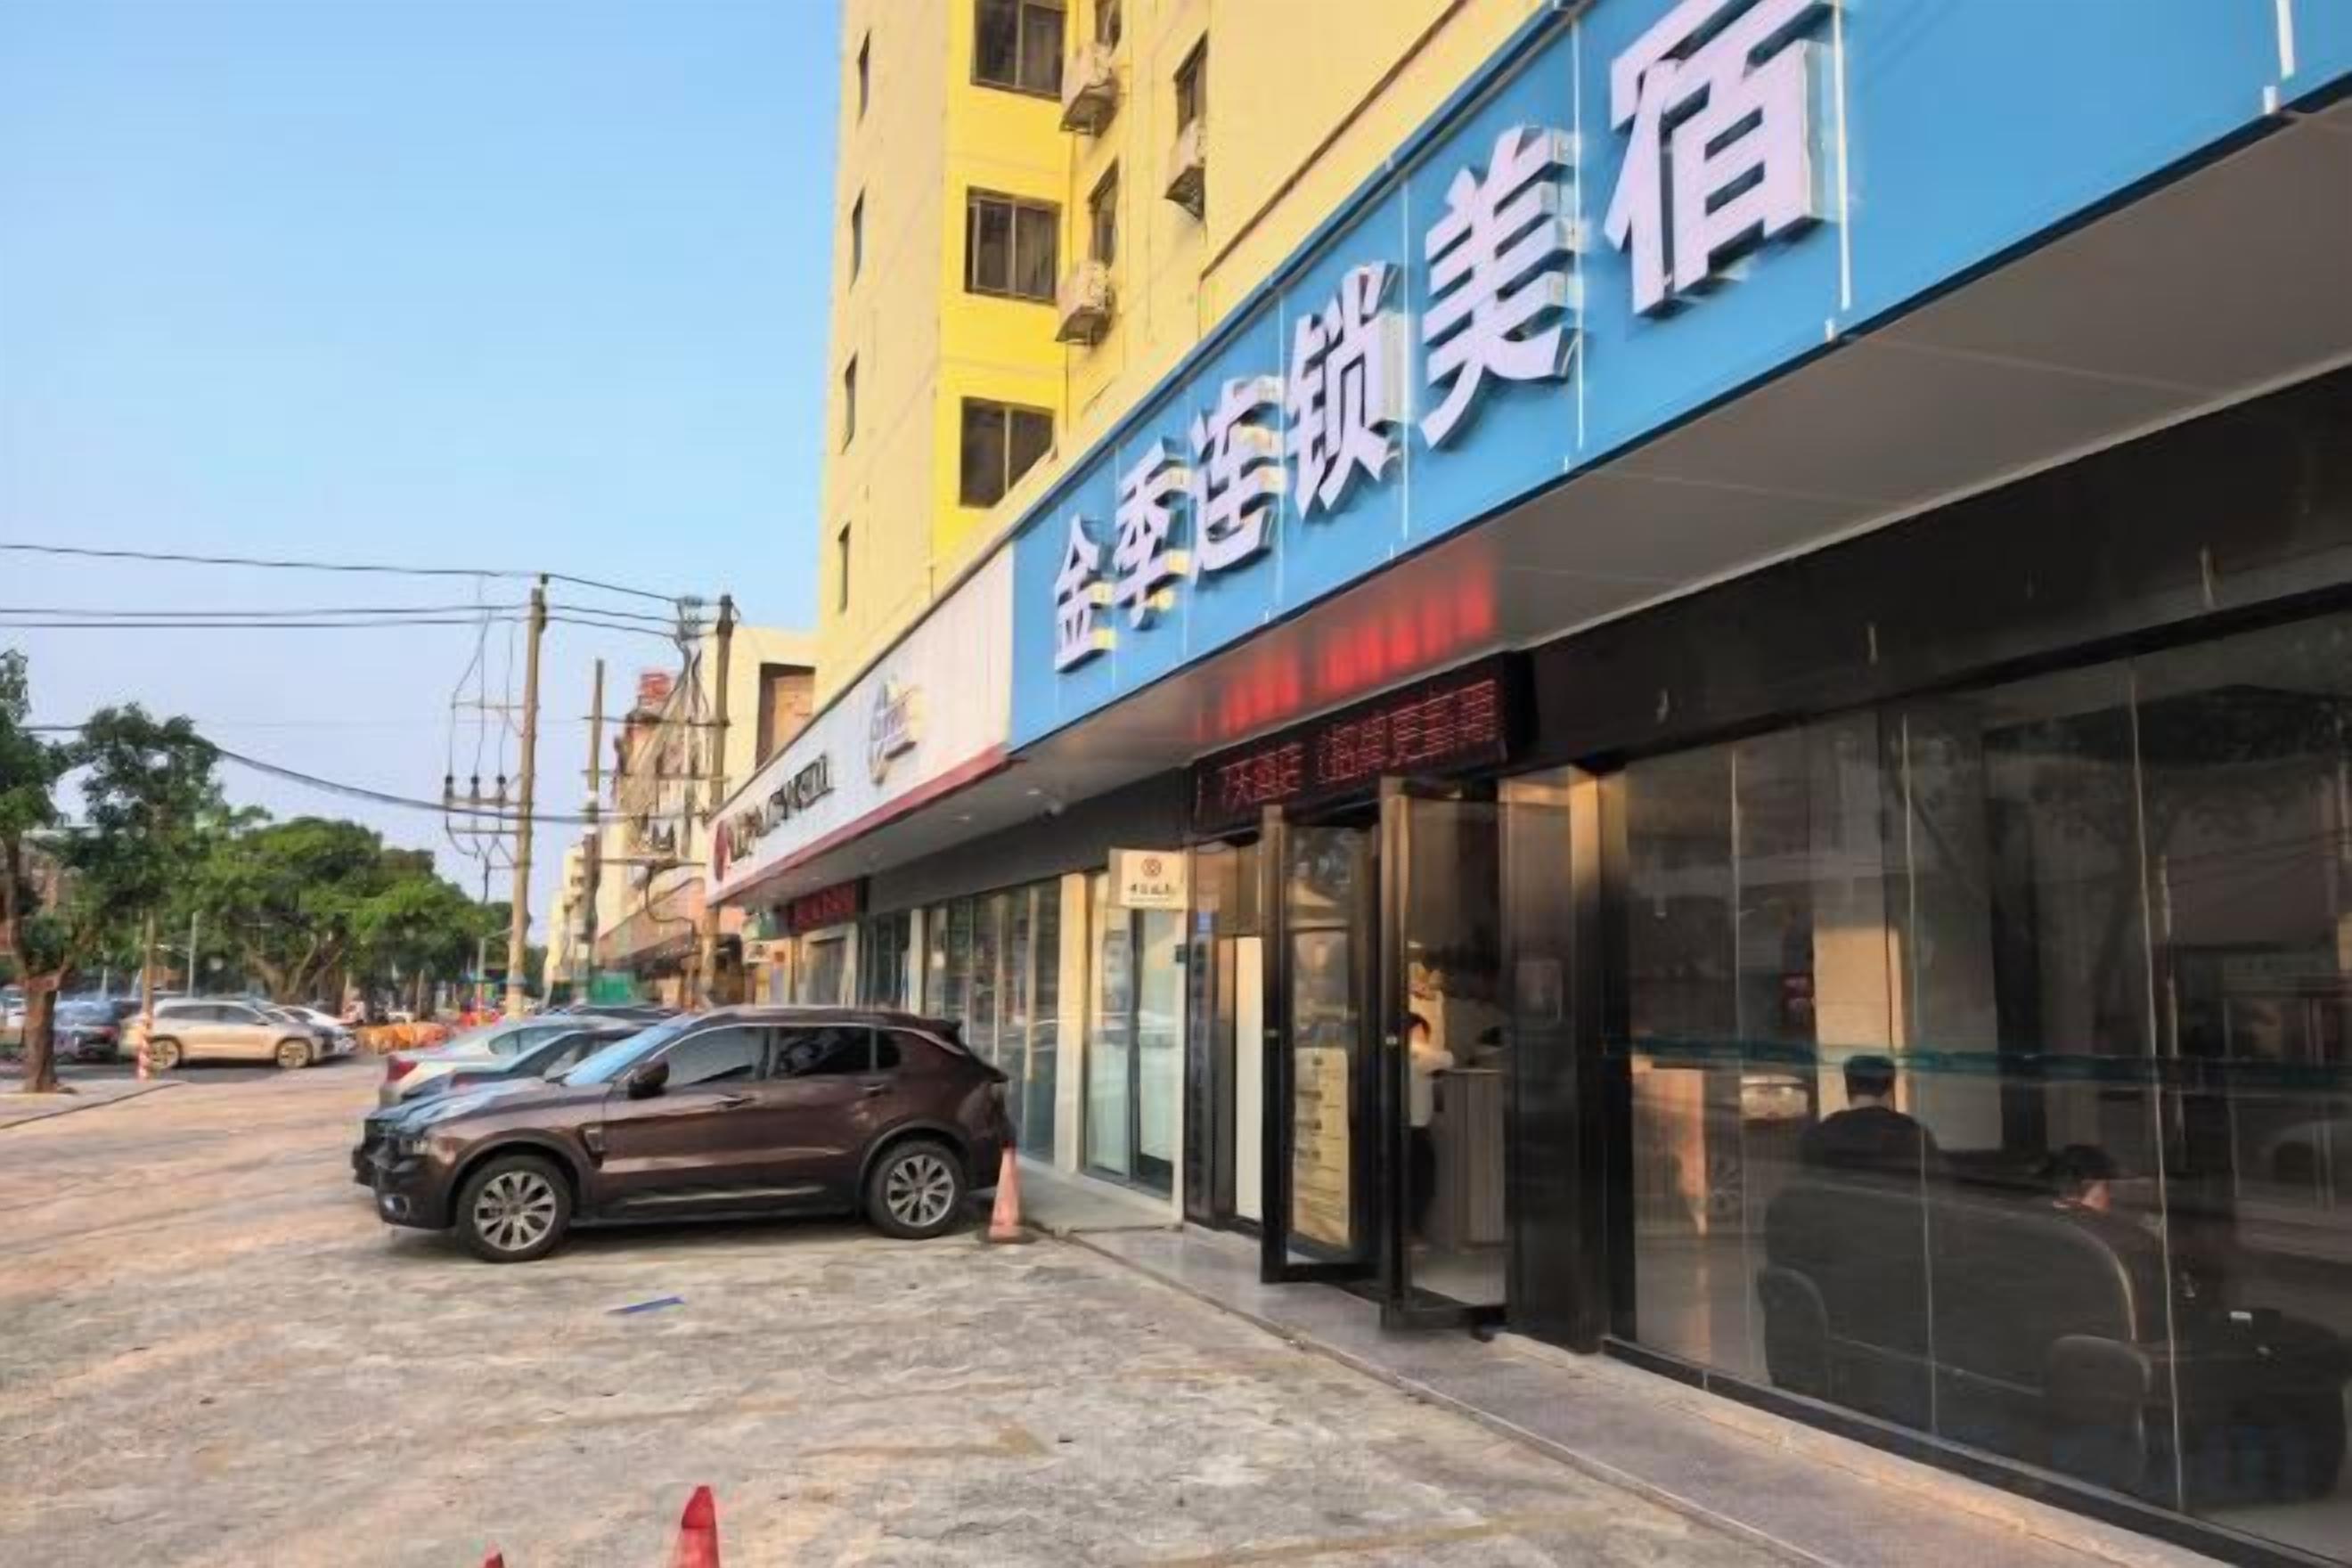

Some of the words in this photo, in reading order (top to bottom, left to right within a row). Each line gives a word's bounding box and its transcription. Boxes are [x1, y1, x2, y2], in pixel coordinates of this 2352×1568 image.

[1053, 0, 1839, 673] 金季连锁美宿
